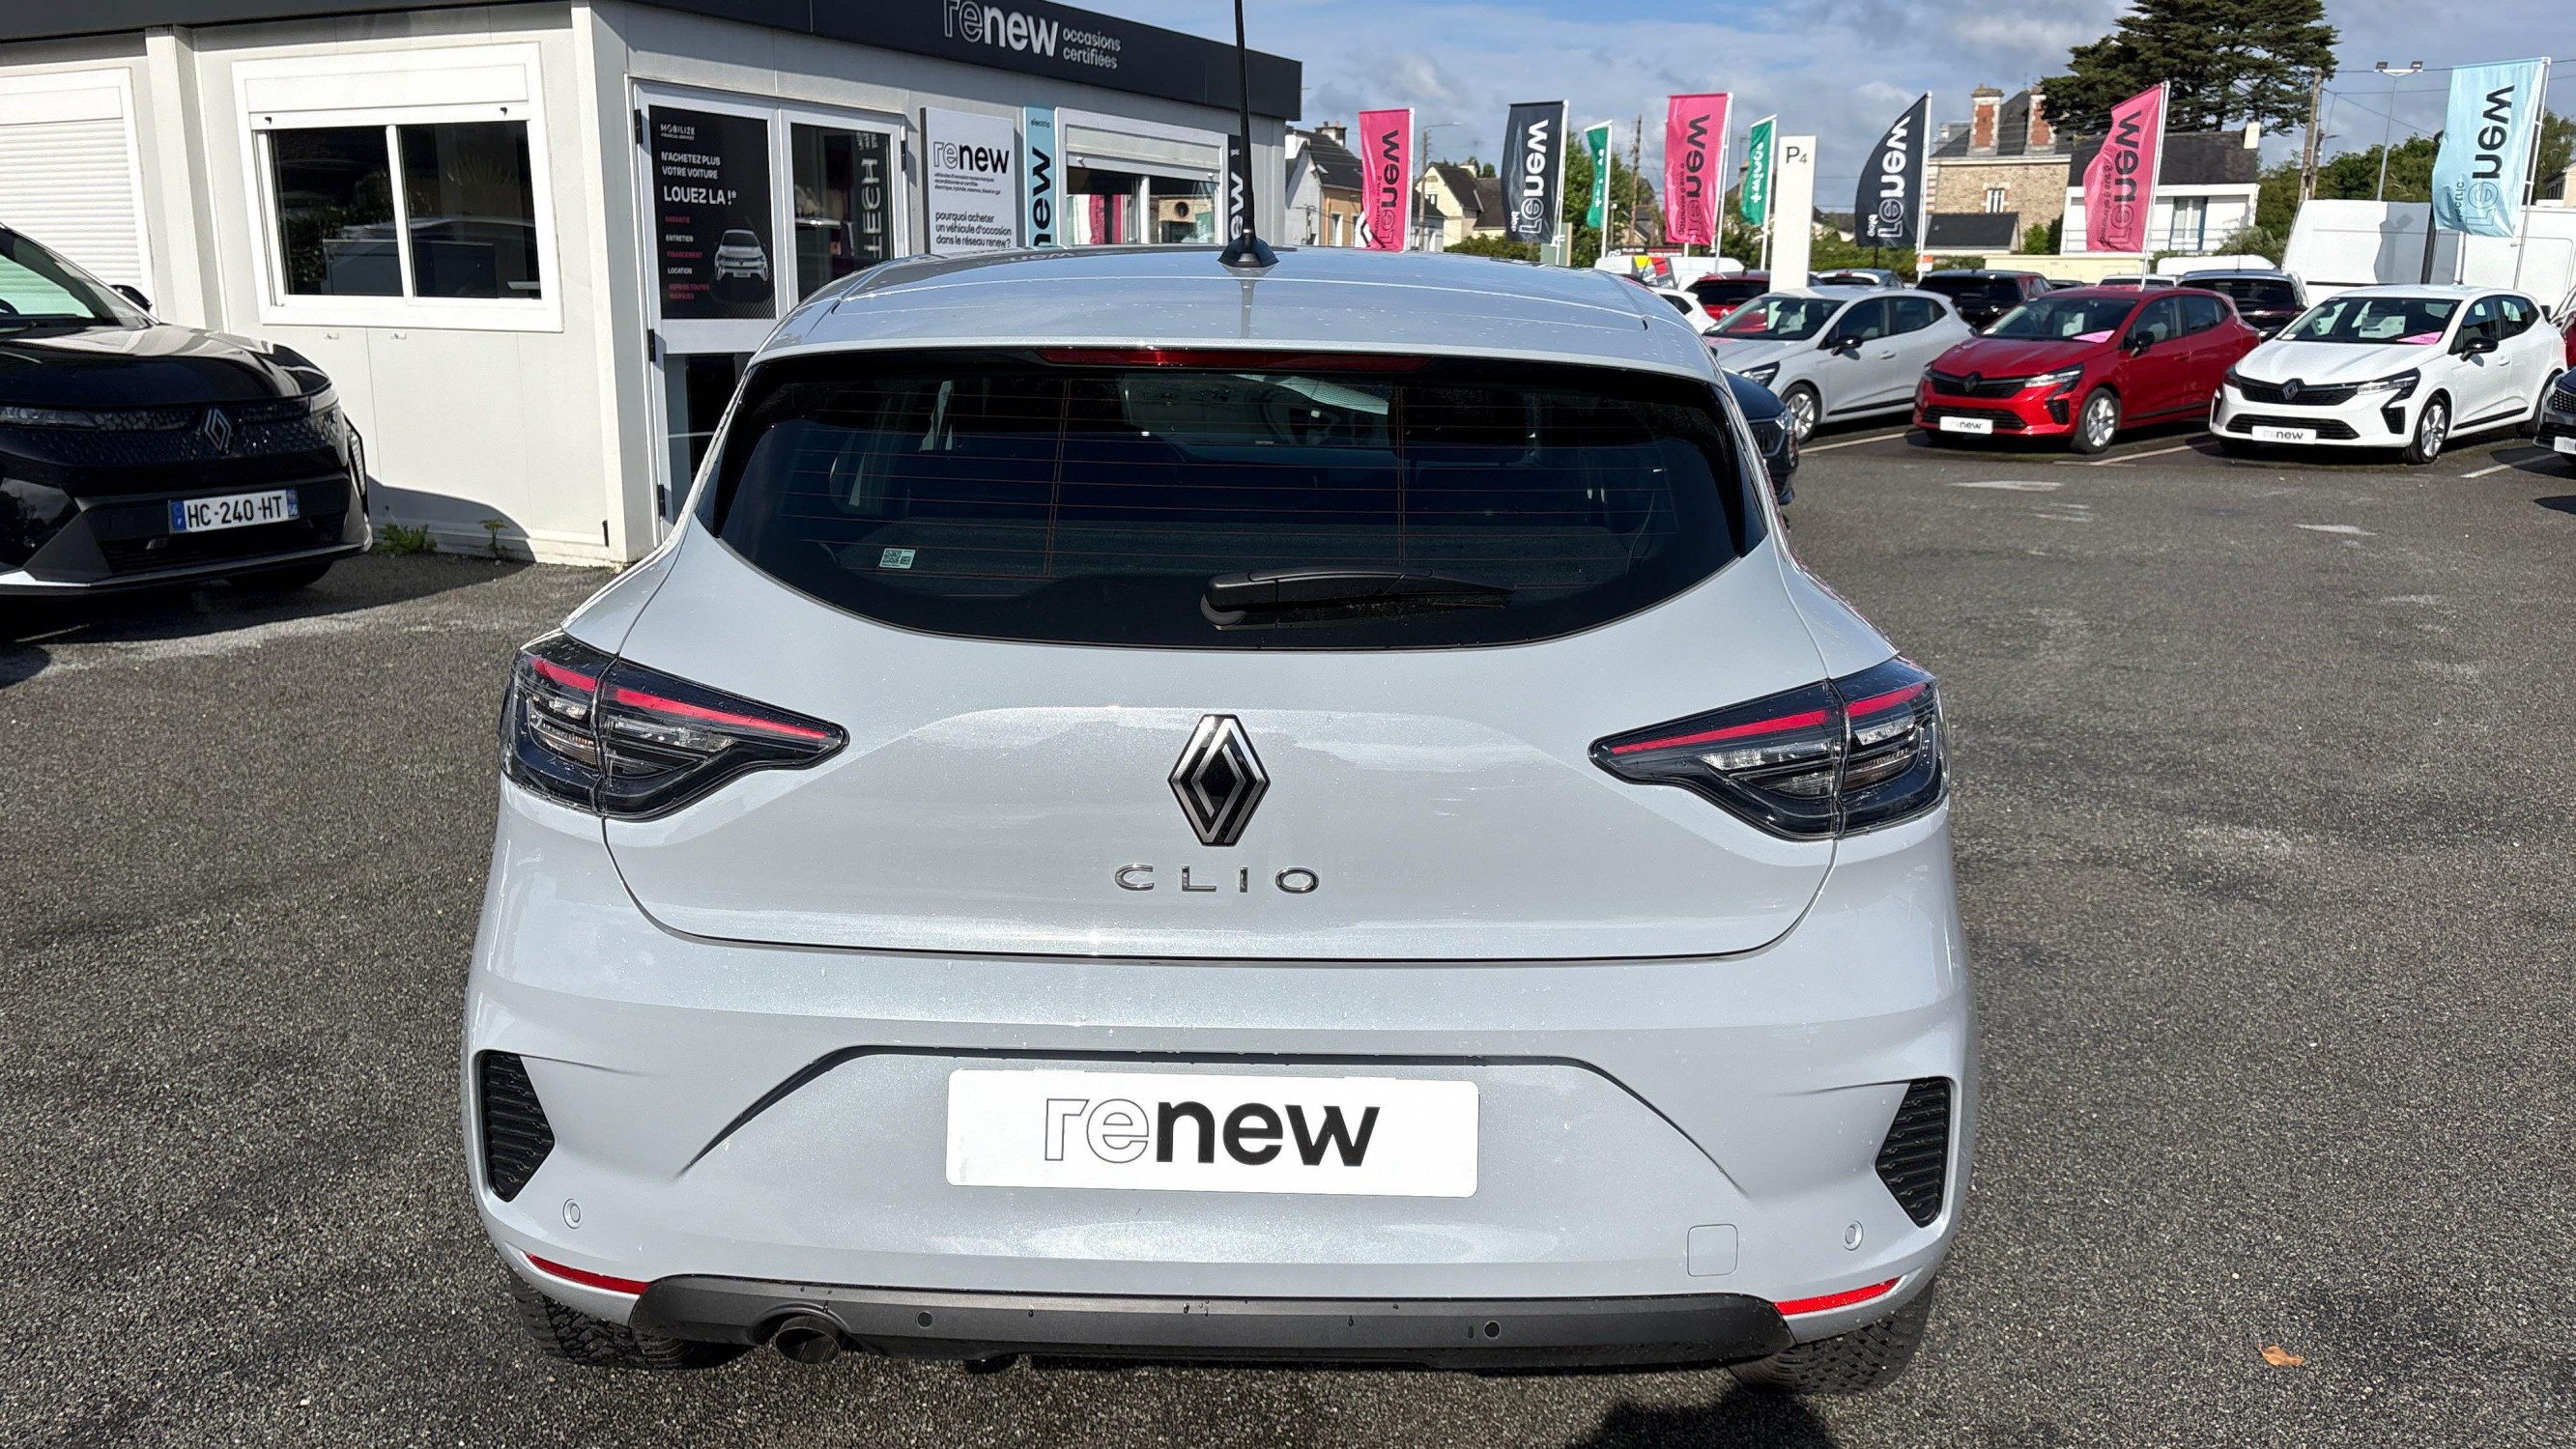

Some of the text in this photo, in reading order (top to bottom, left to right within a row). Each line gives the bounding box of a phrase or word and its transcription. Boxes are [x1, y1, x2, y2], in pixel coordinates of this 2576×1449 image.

[943, 0, 1059, 57] renew
[1063, 27, 1121, 51] occasions
[1063, 46, 1118, 70] certifiées
[660, 124, 695, 135] MOBILIZE
[661, 152, 721, 166] N'ACHETEZ PLUS
[933, 141, 1010, 174] renew
[662, 165, 718, 180] VOTRE VOITURE
[663, 185, 706, 204] LOUEZ
[709, 188, 726, 205] LA
[935, 212, 994, 223] pourquoi acheter
[665, 234, 694, 242] ENTRETIEN
[935, 234, 955, 244] dans
[955, 235, 960, 245] le
[961, 236, 986, 246] réseau
[946, 223, 975, 234] véhicule
[975, 225, 1012, 237] d'occasion
[186, 496, 281, 527] HC-240-HT
[1114, 864, 1320, 895] CLIO
[1045, 1098, 1381, 1167] renew
